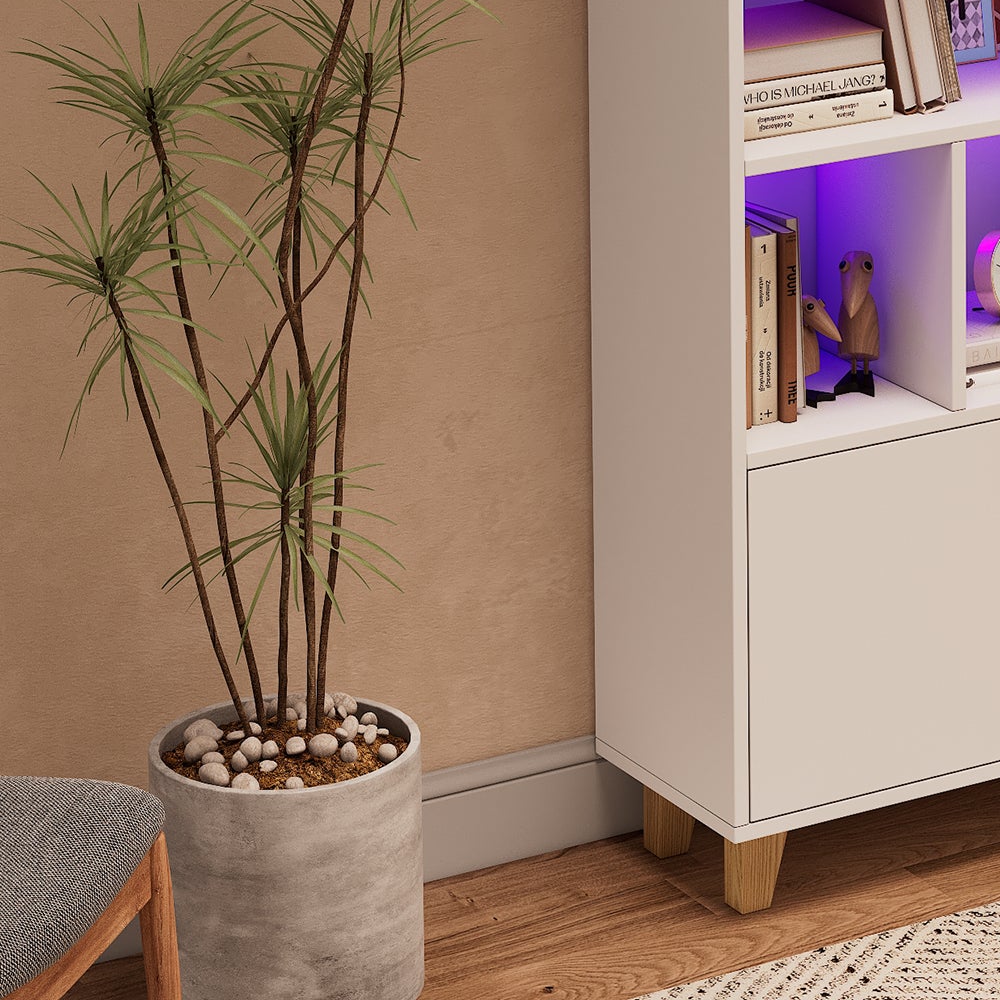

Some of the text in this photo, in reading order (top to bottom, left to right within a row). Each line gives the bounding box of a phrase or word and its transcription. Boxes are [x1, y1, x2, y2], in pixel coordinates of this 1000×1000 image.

[770, 88, 783, 100] IS
[784, 80, 837, 98] MICHAEL
[838, 74, 876, 90] JANG?
[760, 243, 767, 254] 1
[758, 350, 765, 359] do
[765, 351, 772, 361] Od
